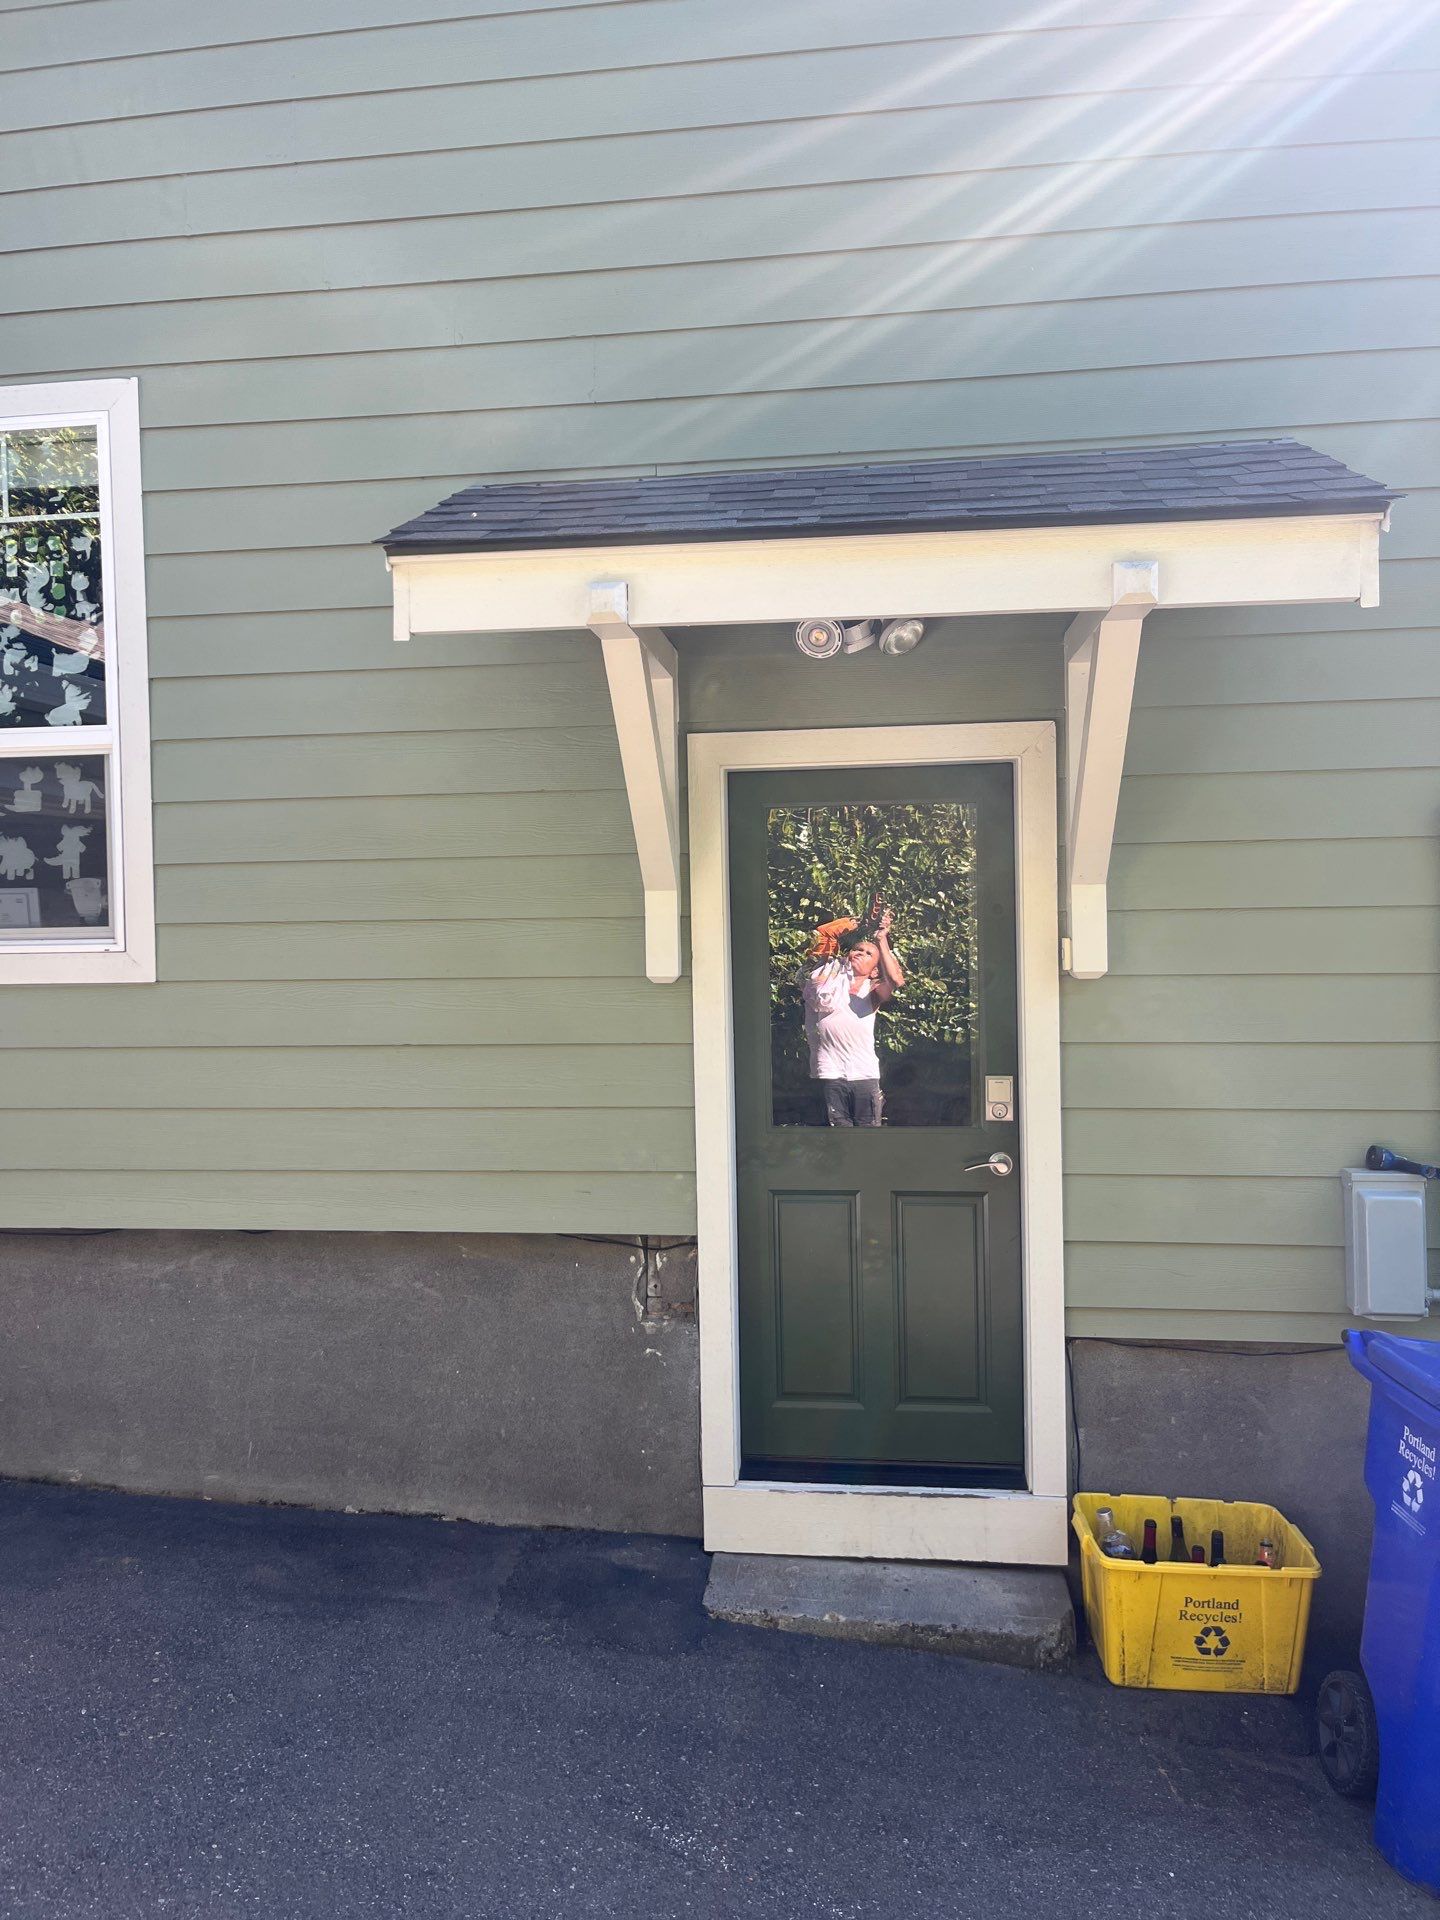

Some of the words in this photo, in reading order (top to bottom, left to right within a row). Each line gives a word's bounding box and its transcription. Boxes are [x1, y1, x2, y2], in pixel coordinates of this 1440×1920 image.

[1403, 1425, 1436, 1462] Portland
[1398, 1439, 1436, 1480] Recycles!
[1184, 1596, 1240, 1610] Portland
[1178, 1609, 1242, 1624] Recycles!
